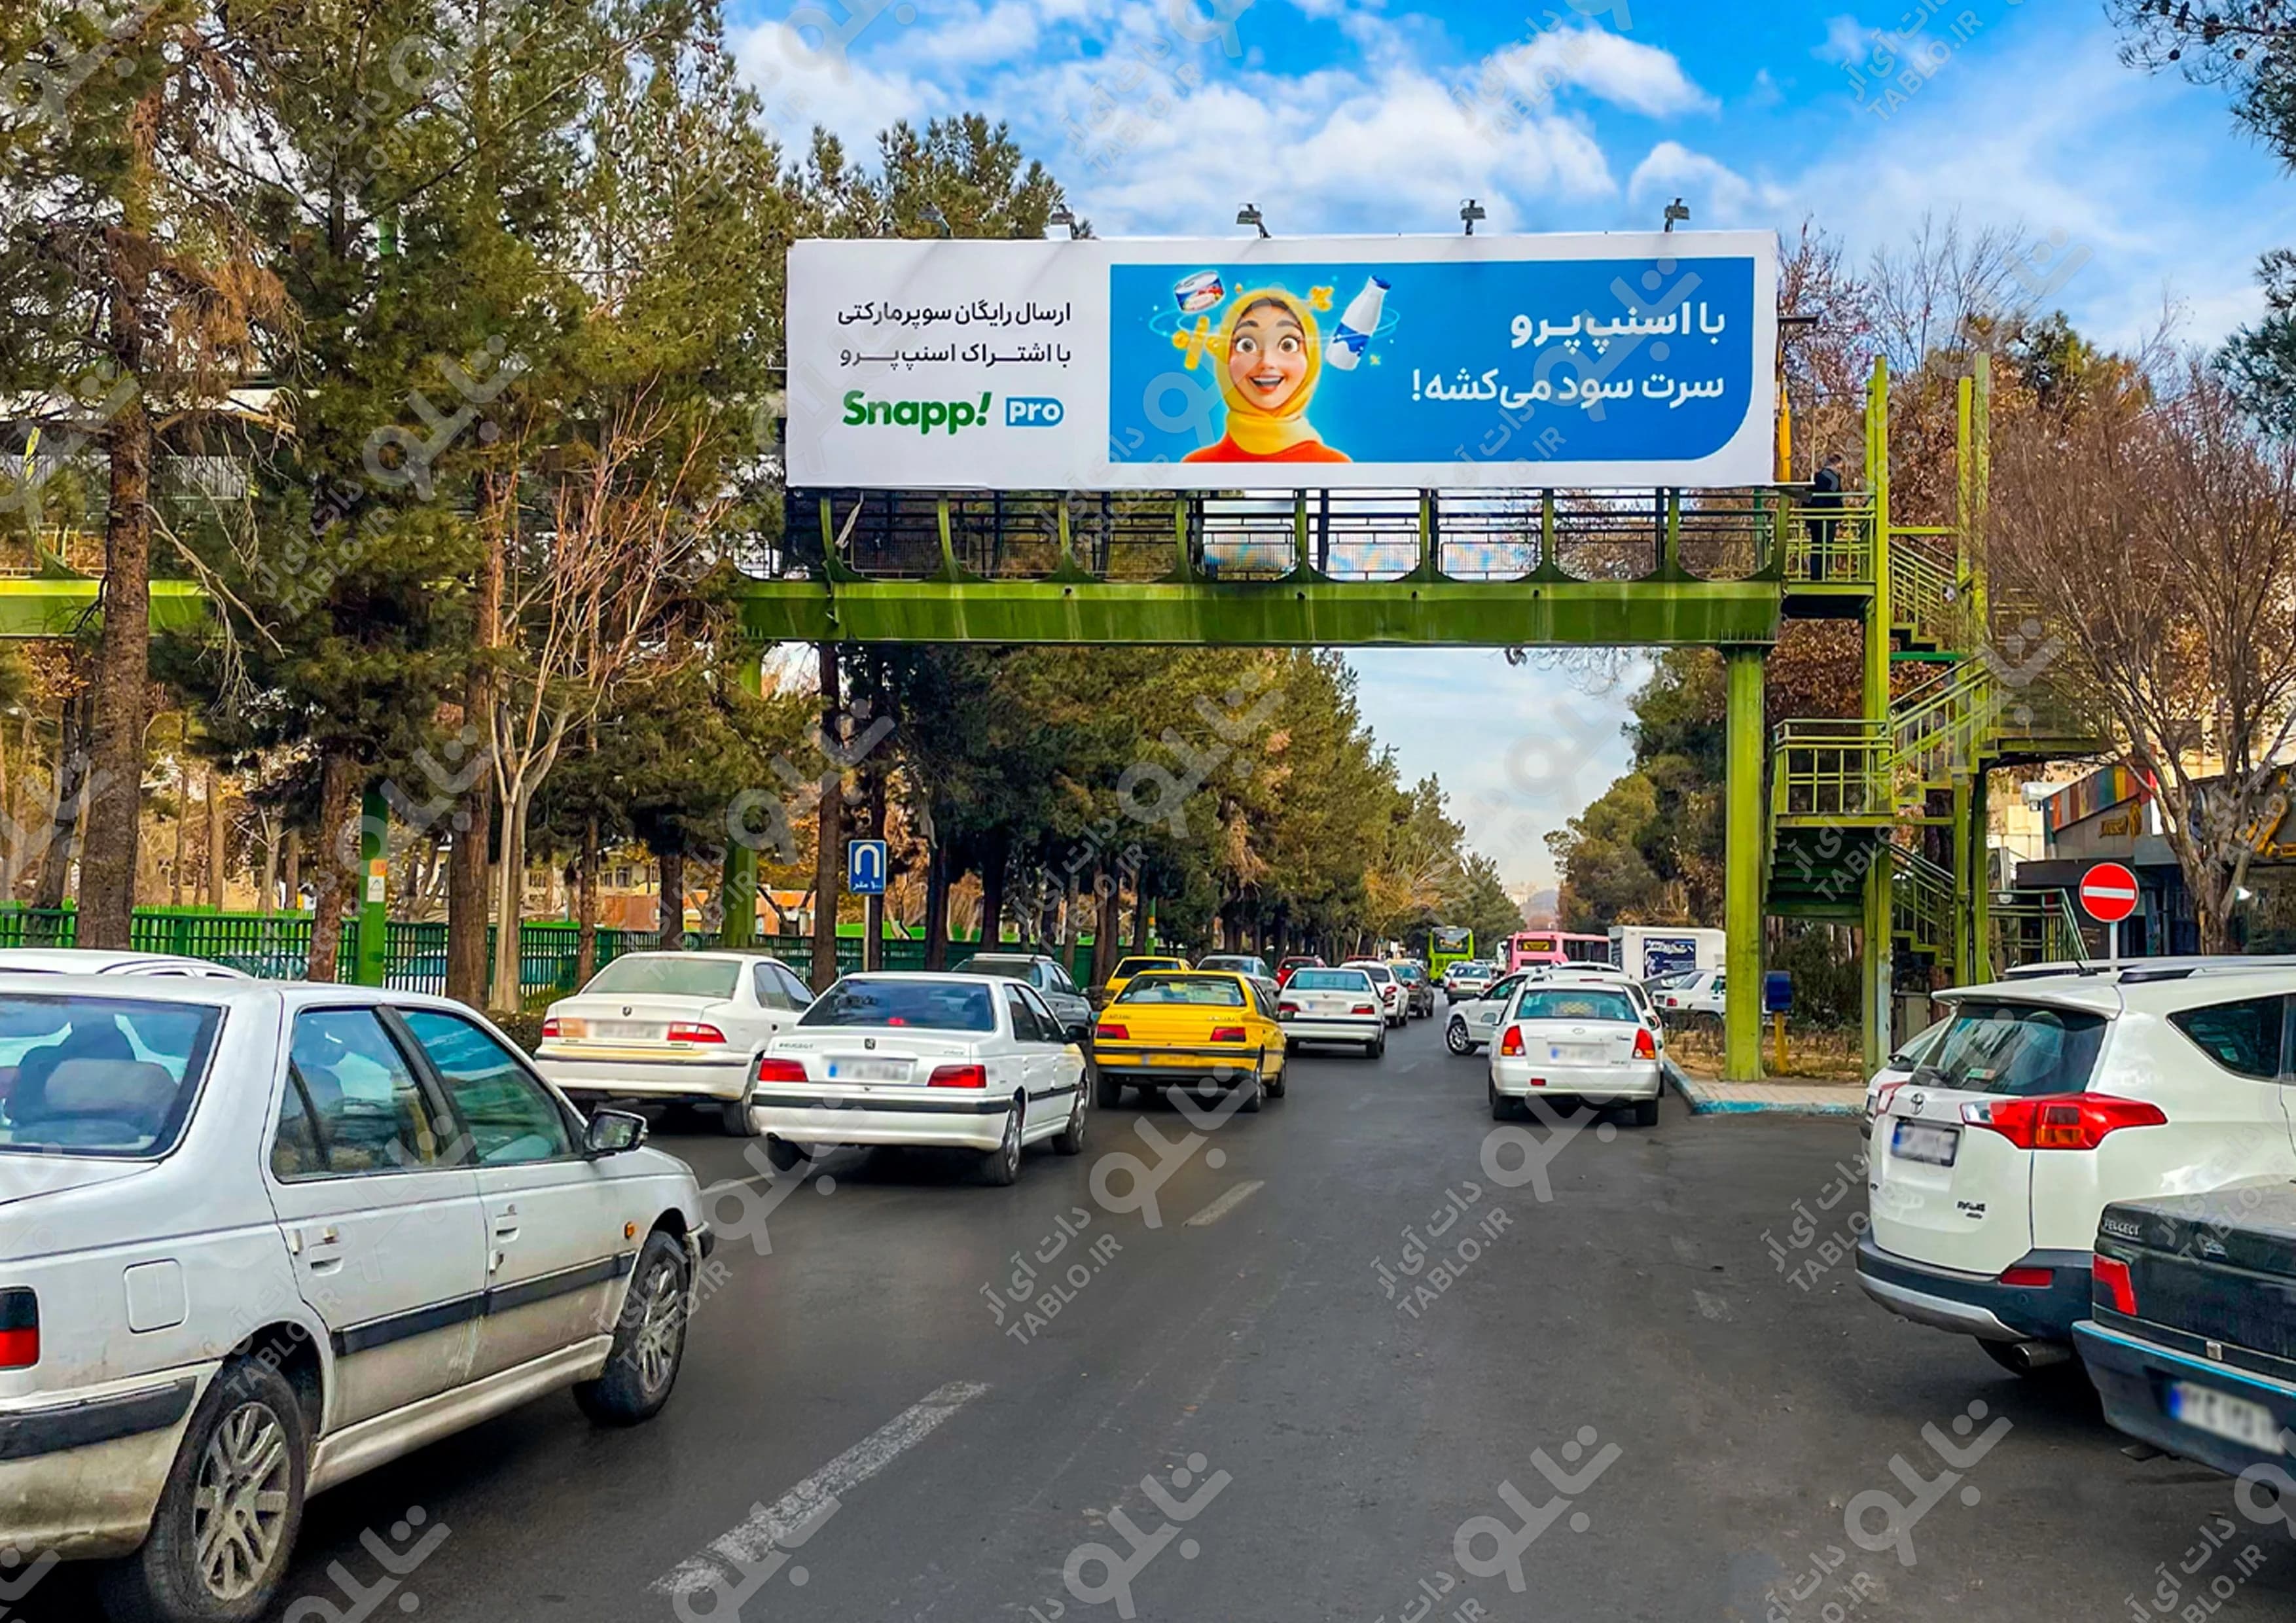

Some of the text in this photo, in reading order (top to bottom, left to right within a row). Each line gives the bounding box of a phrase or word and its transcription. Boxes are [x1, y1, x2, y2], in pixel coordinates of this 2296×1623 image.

[838, 300, 1071, 329] ارسال رایگان سوپرمارکتی
[1700, 302, 1726, 344] با
[1057, 343, 1071, 368] با
[1558, 376, 1634, 409] سود
[1641, 373, 1725, 409] سرت
[842, 390, 992, 435] Snapp!
